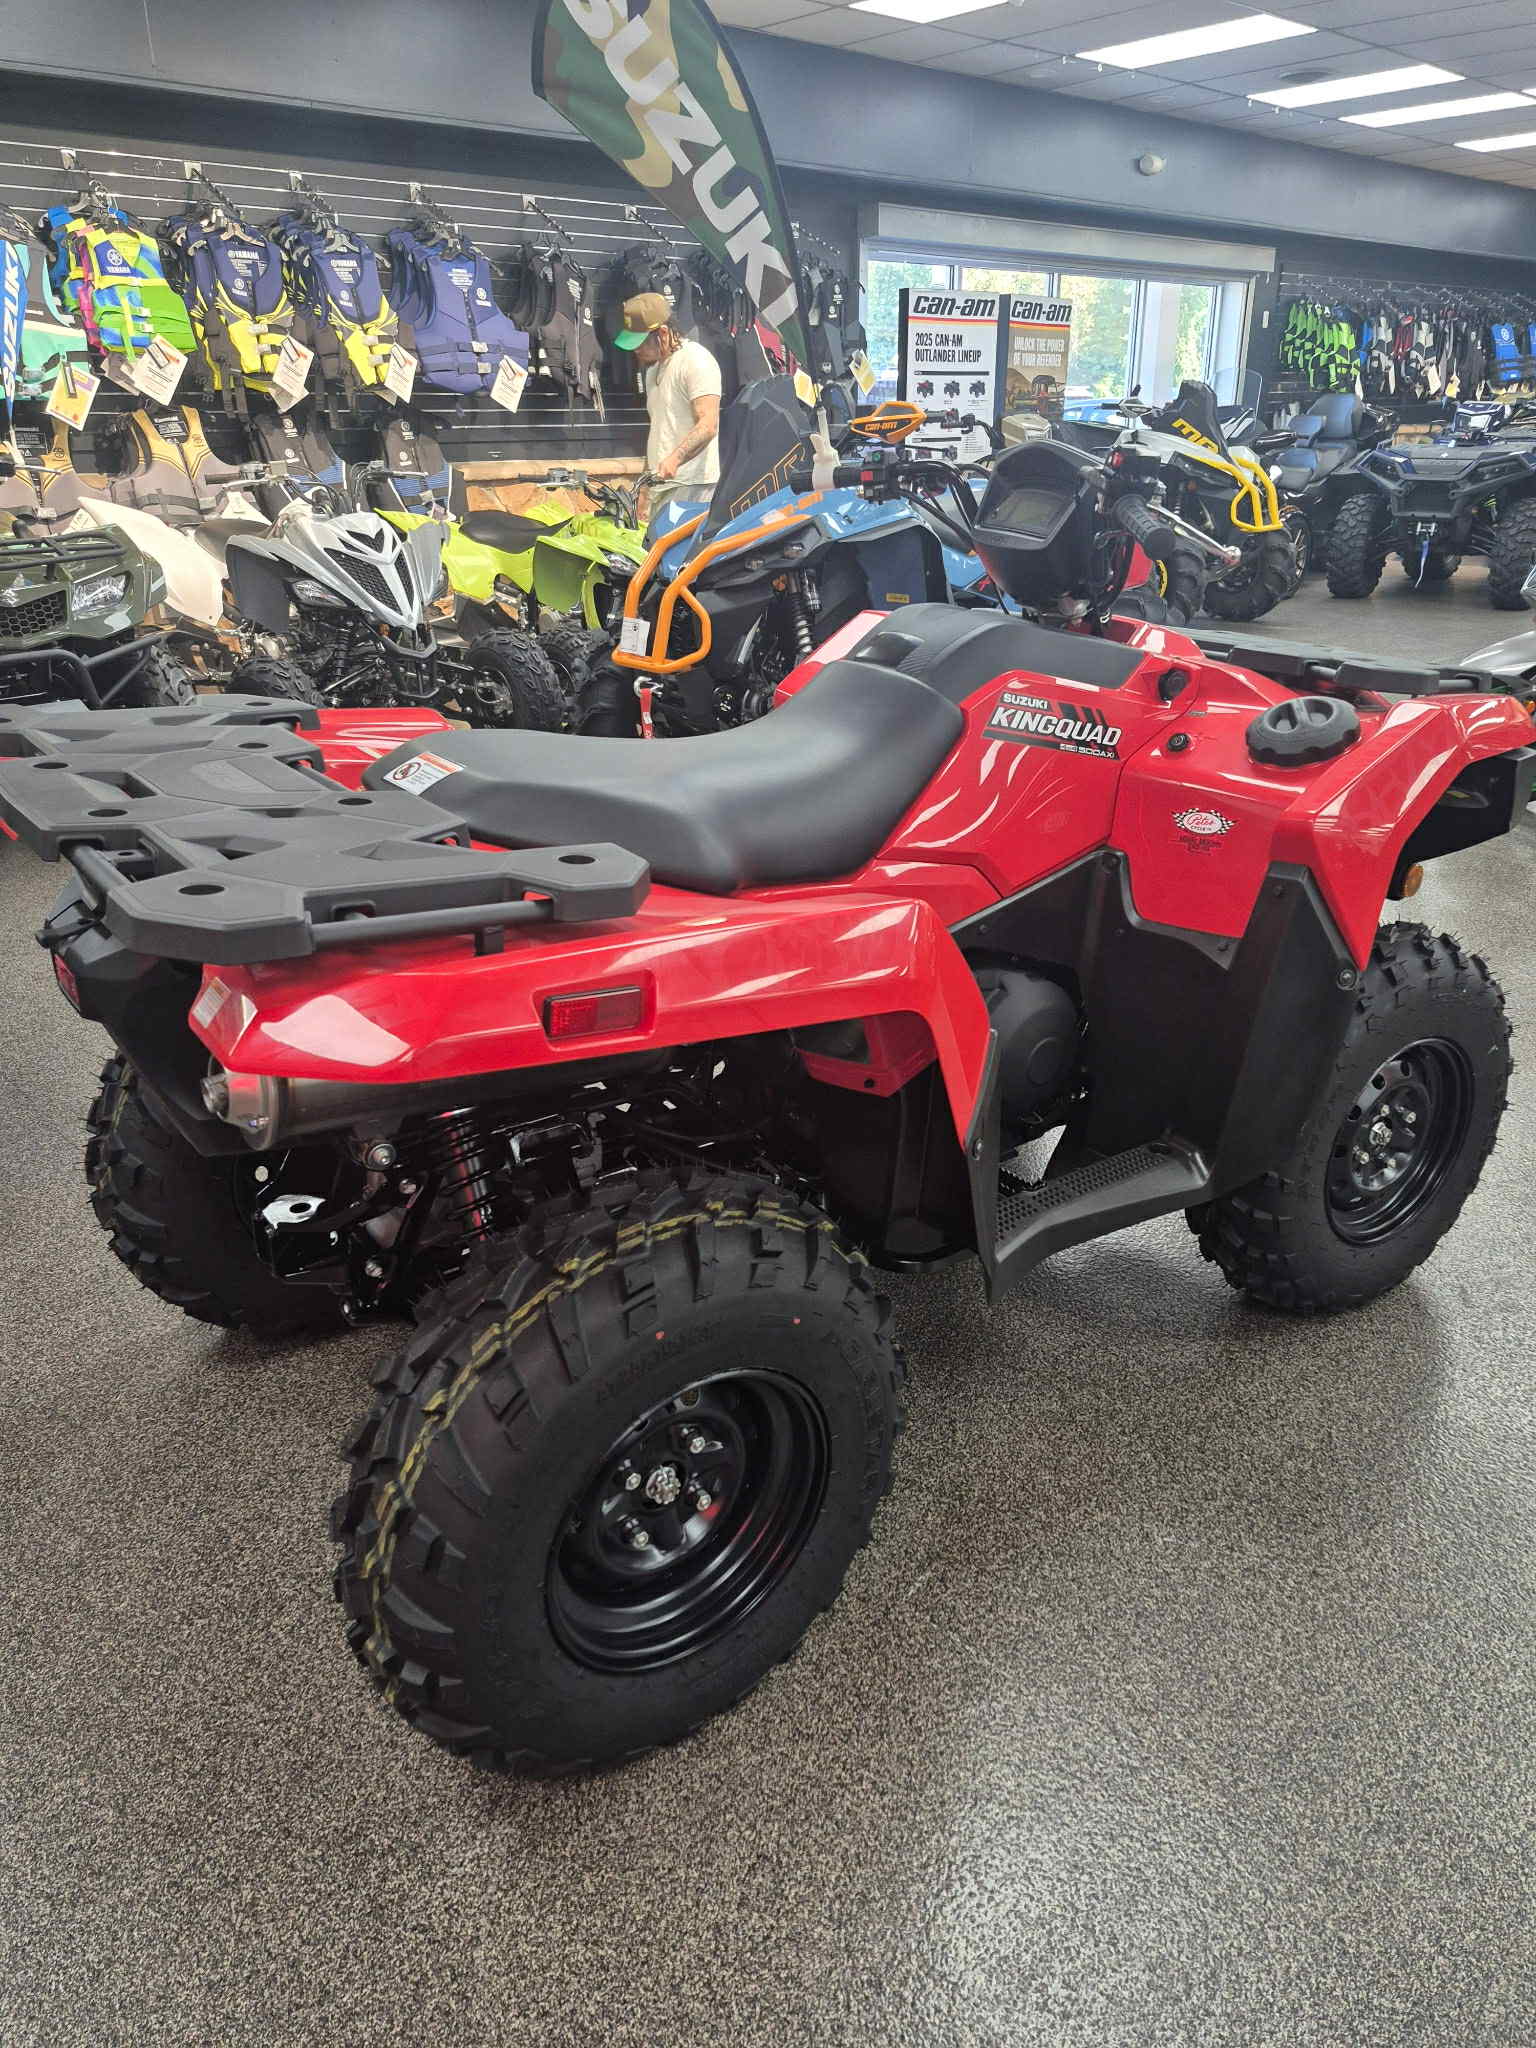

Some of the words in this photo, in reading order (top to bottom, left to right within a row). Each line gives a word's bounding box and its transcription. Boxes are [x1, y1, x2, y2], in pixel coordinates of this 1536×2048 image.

[913, 295, 996, 317] can-am
[1011, 300, 1073, 322] can-am
[915, 333, 933, 346] 2025
[934, 334, 963, 347] CAN-AM
[915, 350, 956, 363] OUTLANDER
[957, 351, 982, 363] LINEUP
[1003, 693, 1049, 710] SUZUKI
[991, 706, 1122, 746] KINGQUAD
